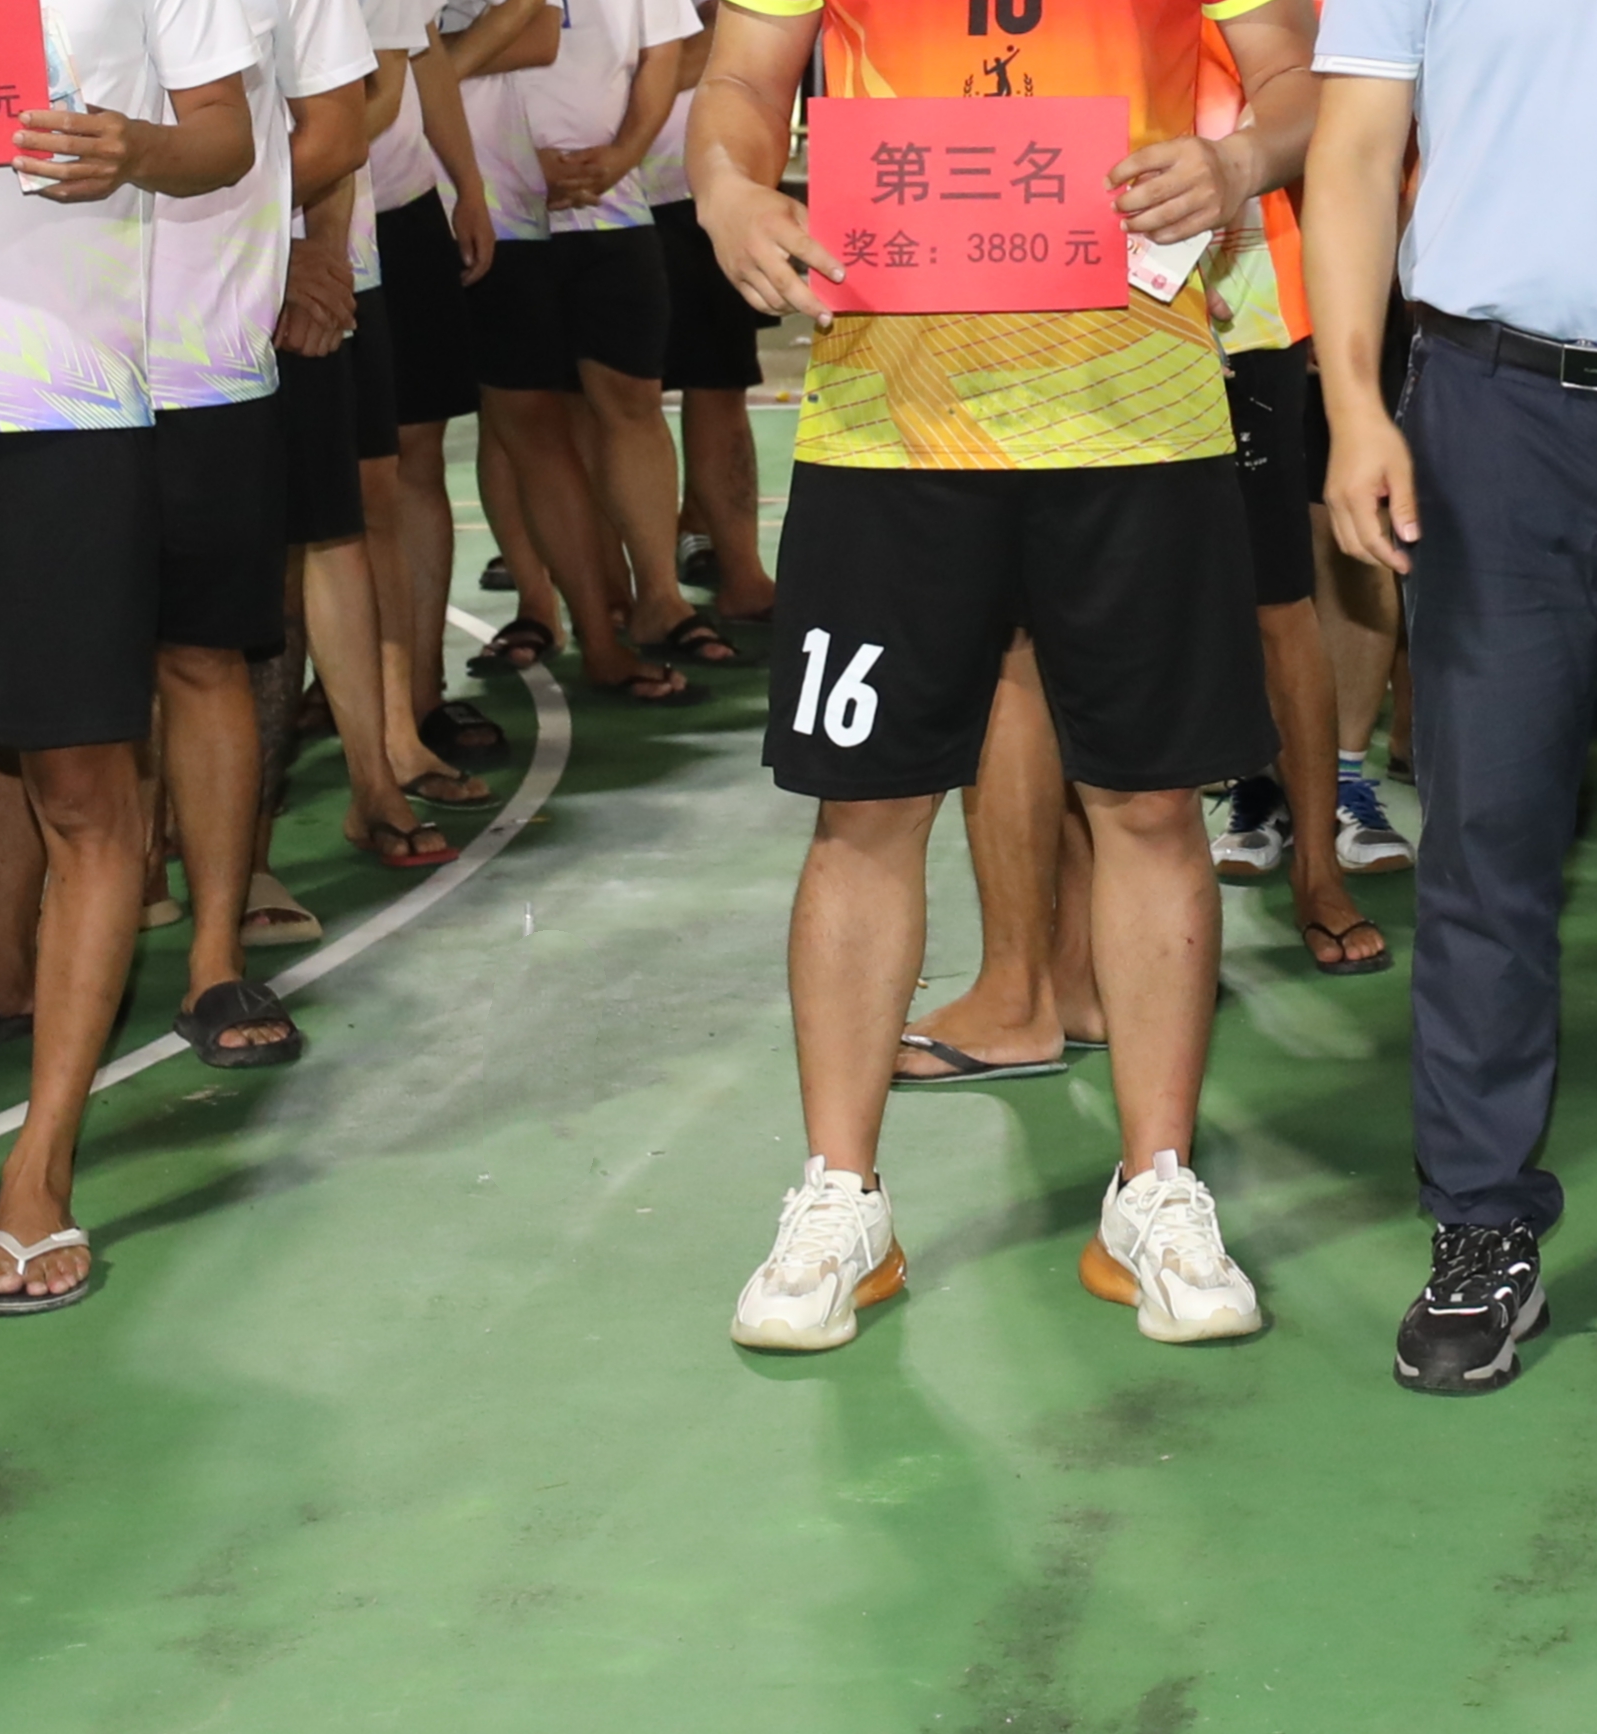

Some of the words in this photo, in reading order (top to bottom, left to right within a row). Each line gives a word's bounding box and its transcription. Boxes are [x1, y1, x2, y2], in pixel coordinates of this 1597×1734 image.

[869, 140, 1067, 206] 第三名
[1064, 229, 1102, 266] 元
[791, 627, 885, 749] 16
